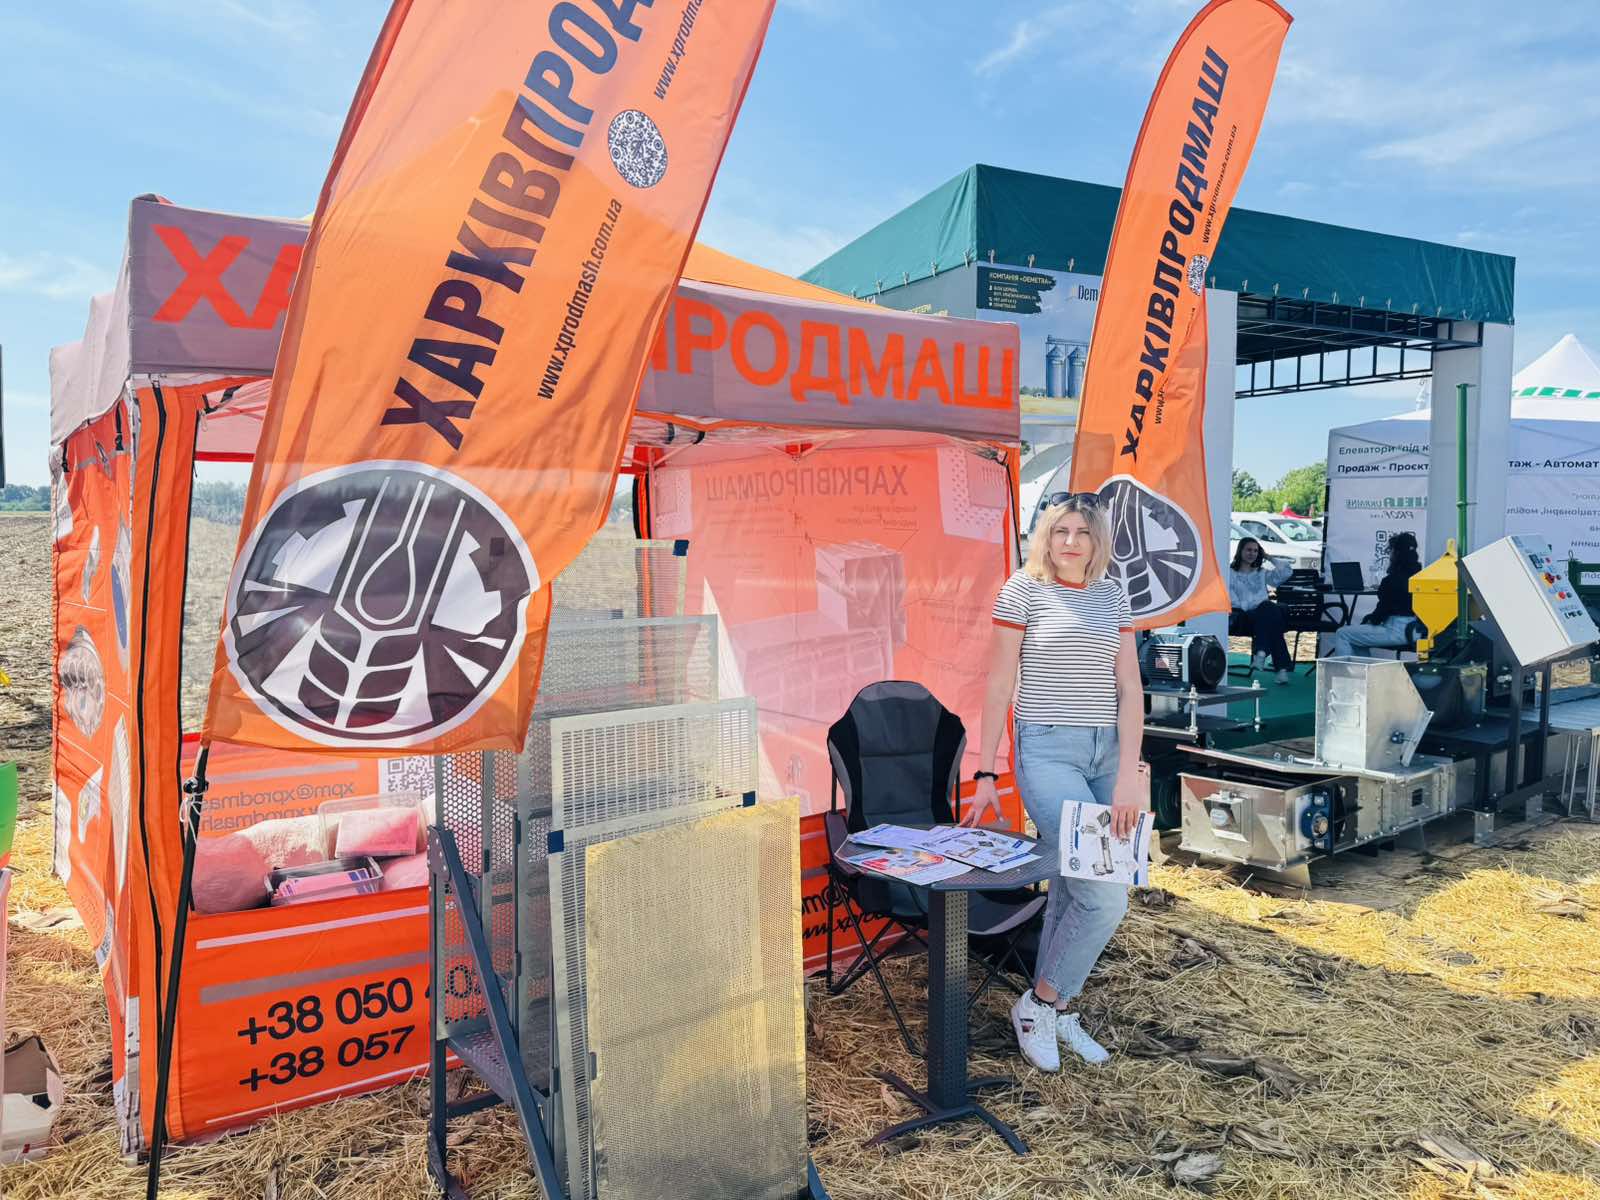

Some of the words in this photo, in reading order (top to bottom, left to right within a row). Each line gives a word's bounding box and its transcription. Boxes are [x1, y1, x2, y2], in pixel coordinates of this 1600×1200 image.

[1121, 45, 1230, 460] ХАРКІВПРОДМАШ
[536, 198, 622, 400] www.xprodmash.com.ua
[1337, 464, 1380, 474] Продаж
[1543, 459, 1600, 469] Автомат
[237, 995, 324, 1046] +38
[335, 977, 413, 1026] 050
[239, 1045, 324, 1092] +38
[337, 1025, 415, 1069] 057
